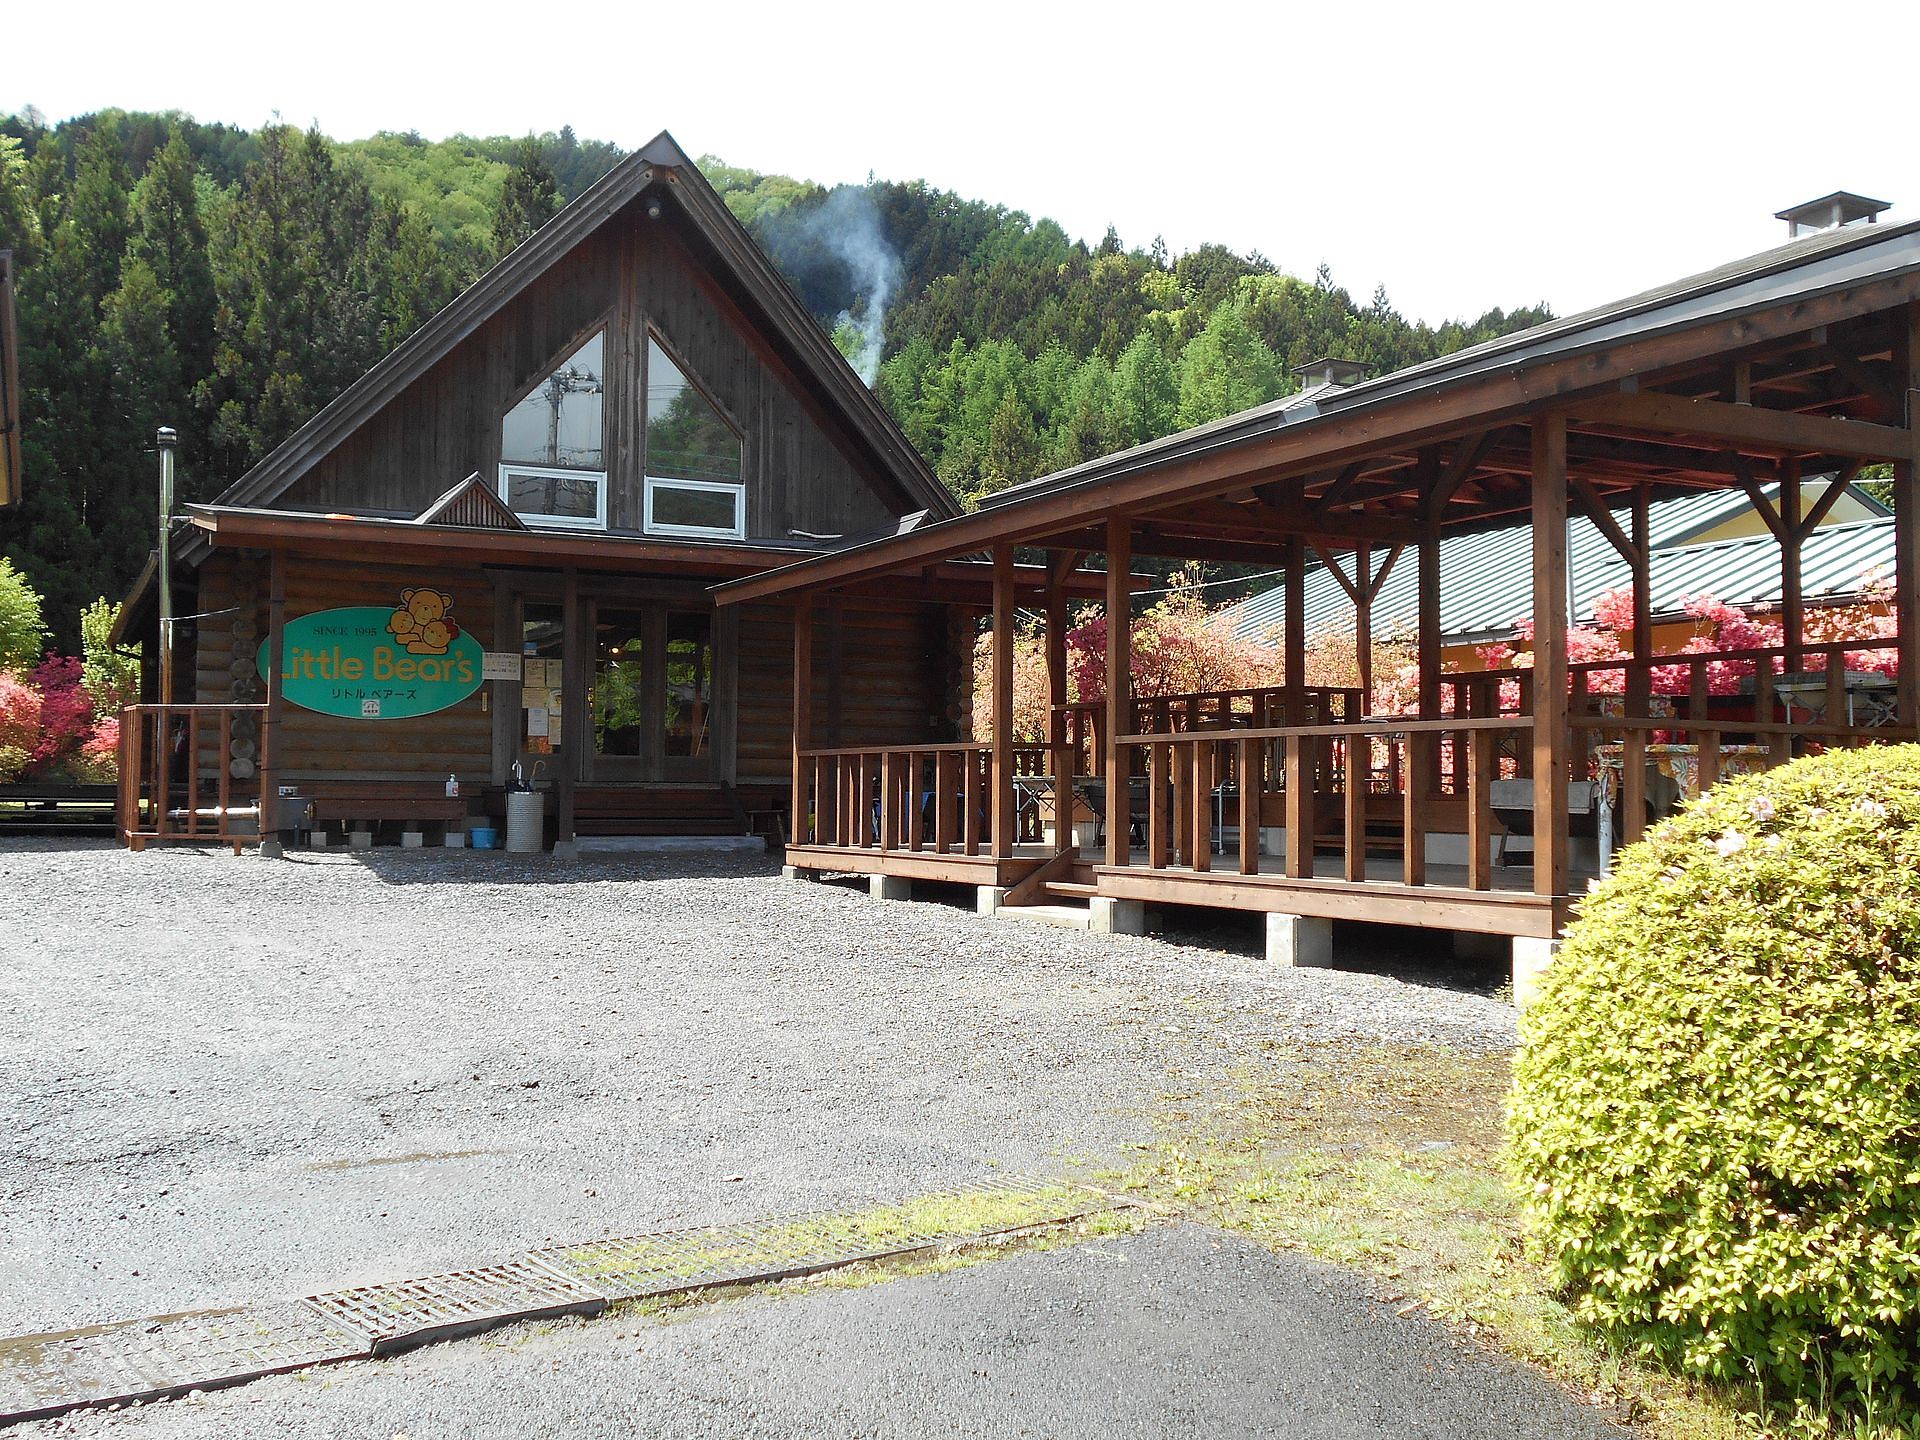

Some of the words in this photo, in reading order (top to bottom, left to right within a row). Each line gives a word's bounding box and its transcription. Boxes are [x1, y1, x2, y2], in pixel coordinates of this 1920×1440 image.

[313, 627, 348, 636] SINCE
[355, 627, 377, 637] 1995
[373, 646, 473, 683] Bear's
[332, 688, 366, 700] リトル
[372, 688, 417, 700] ベアーズ
